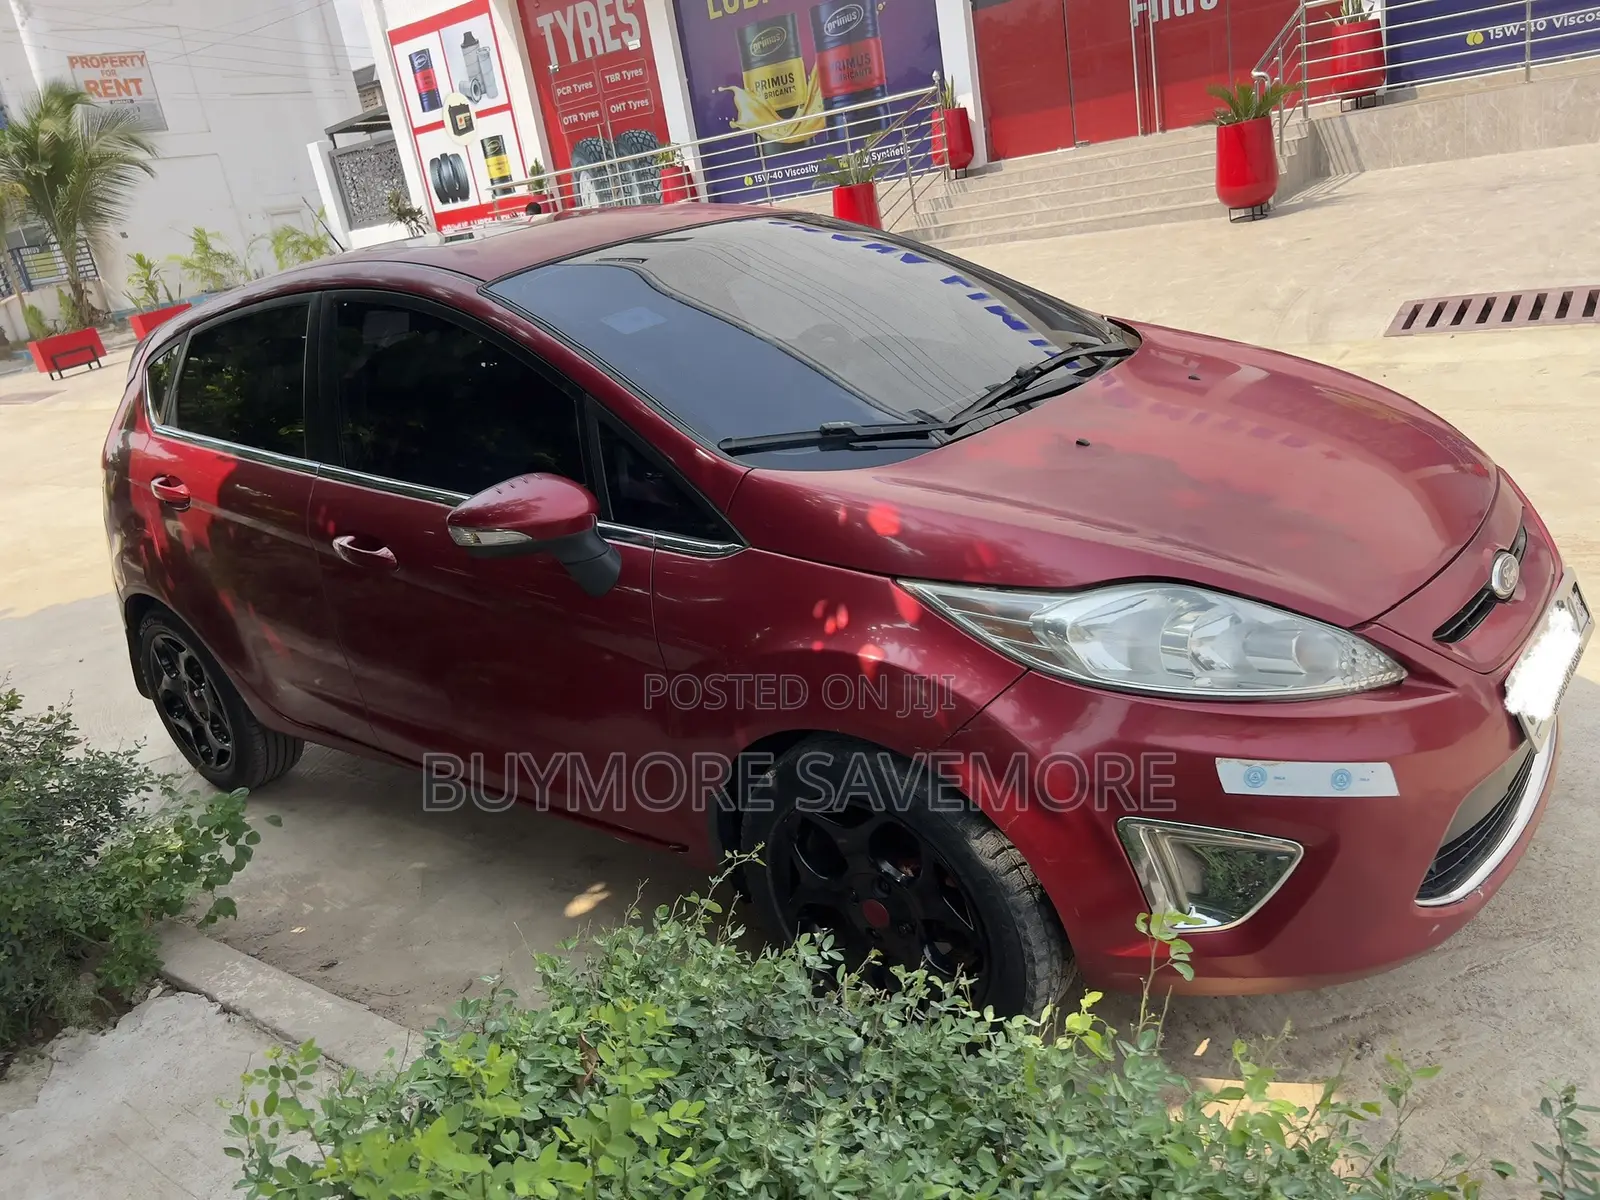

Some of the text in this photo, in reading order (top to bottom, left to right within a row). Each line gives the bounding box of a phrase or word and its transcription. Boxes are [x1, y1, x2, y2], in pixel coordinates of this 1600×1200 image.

[827, 9, 858, 33] primus
[536, 0, 641, 66] TYRES
[68, 54, 146, 69] PROPERTY
[101, 69, 117, 77] FOR
[605, 68, 643, 84] TBR Tyres
[84, 78, 143, 98] RENT
[556, 81, 593, 97] PCR Tyres
[755, 72, 795, 91] PRIMUS
[763, 86, 797, 100] BRICANT
[610, 98, 649, 113] OHT Tyres
[562, 109, 599, 125] OTR Tyres
[871, 146, 911, 161] Synthetc
[785, 164, 820, 178] Viscosity
